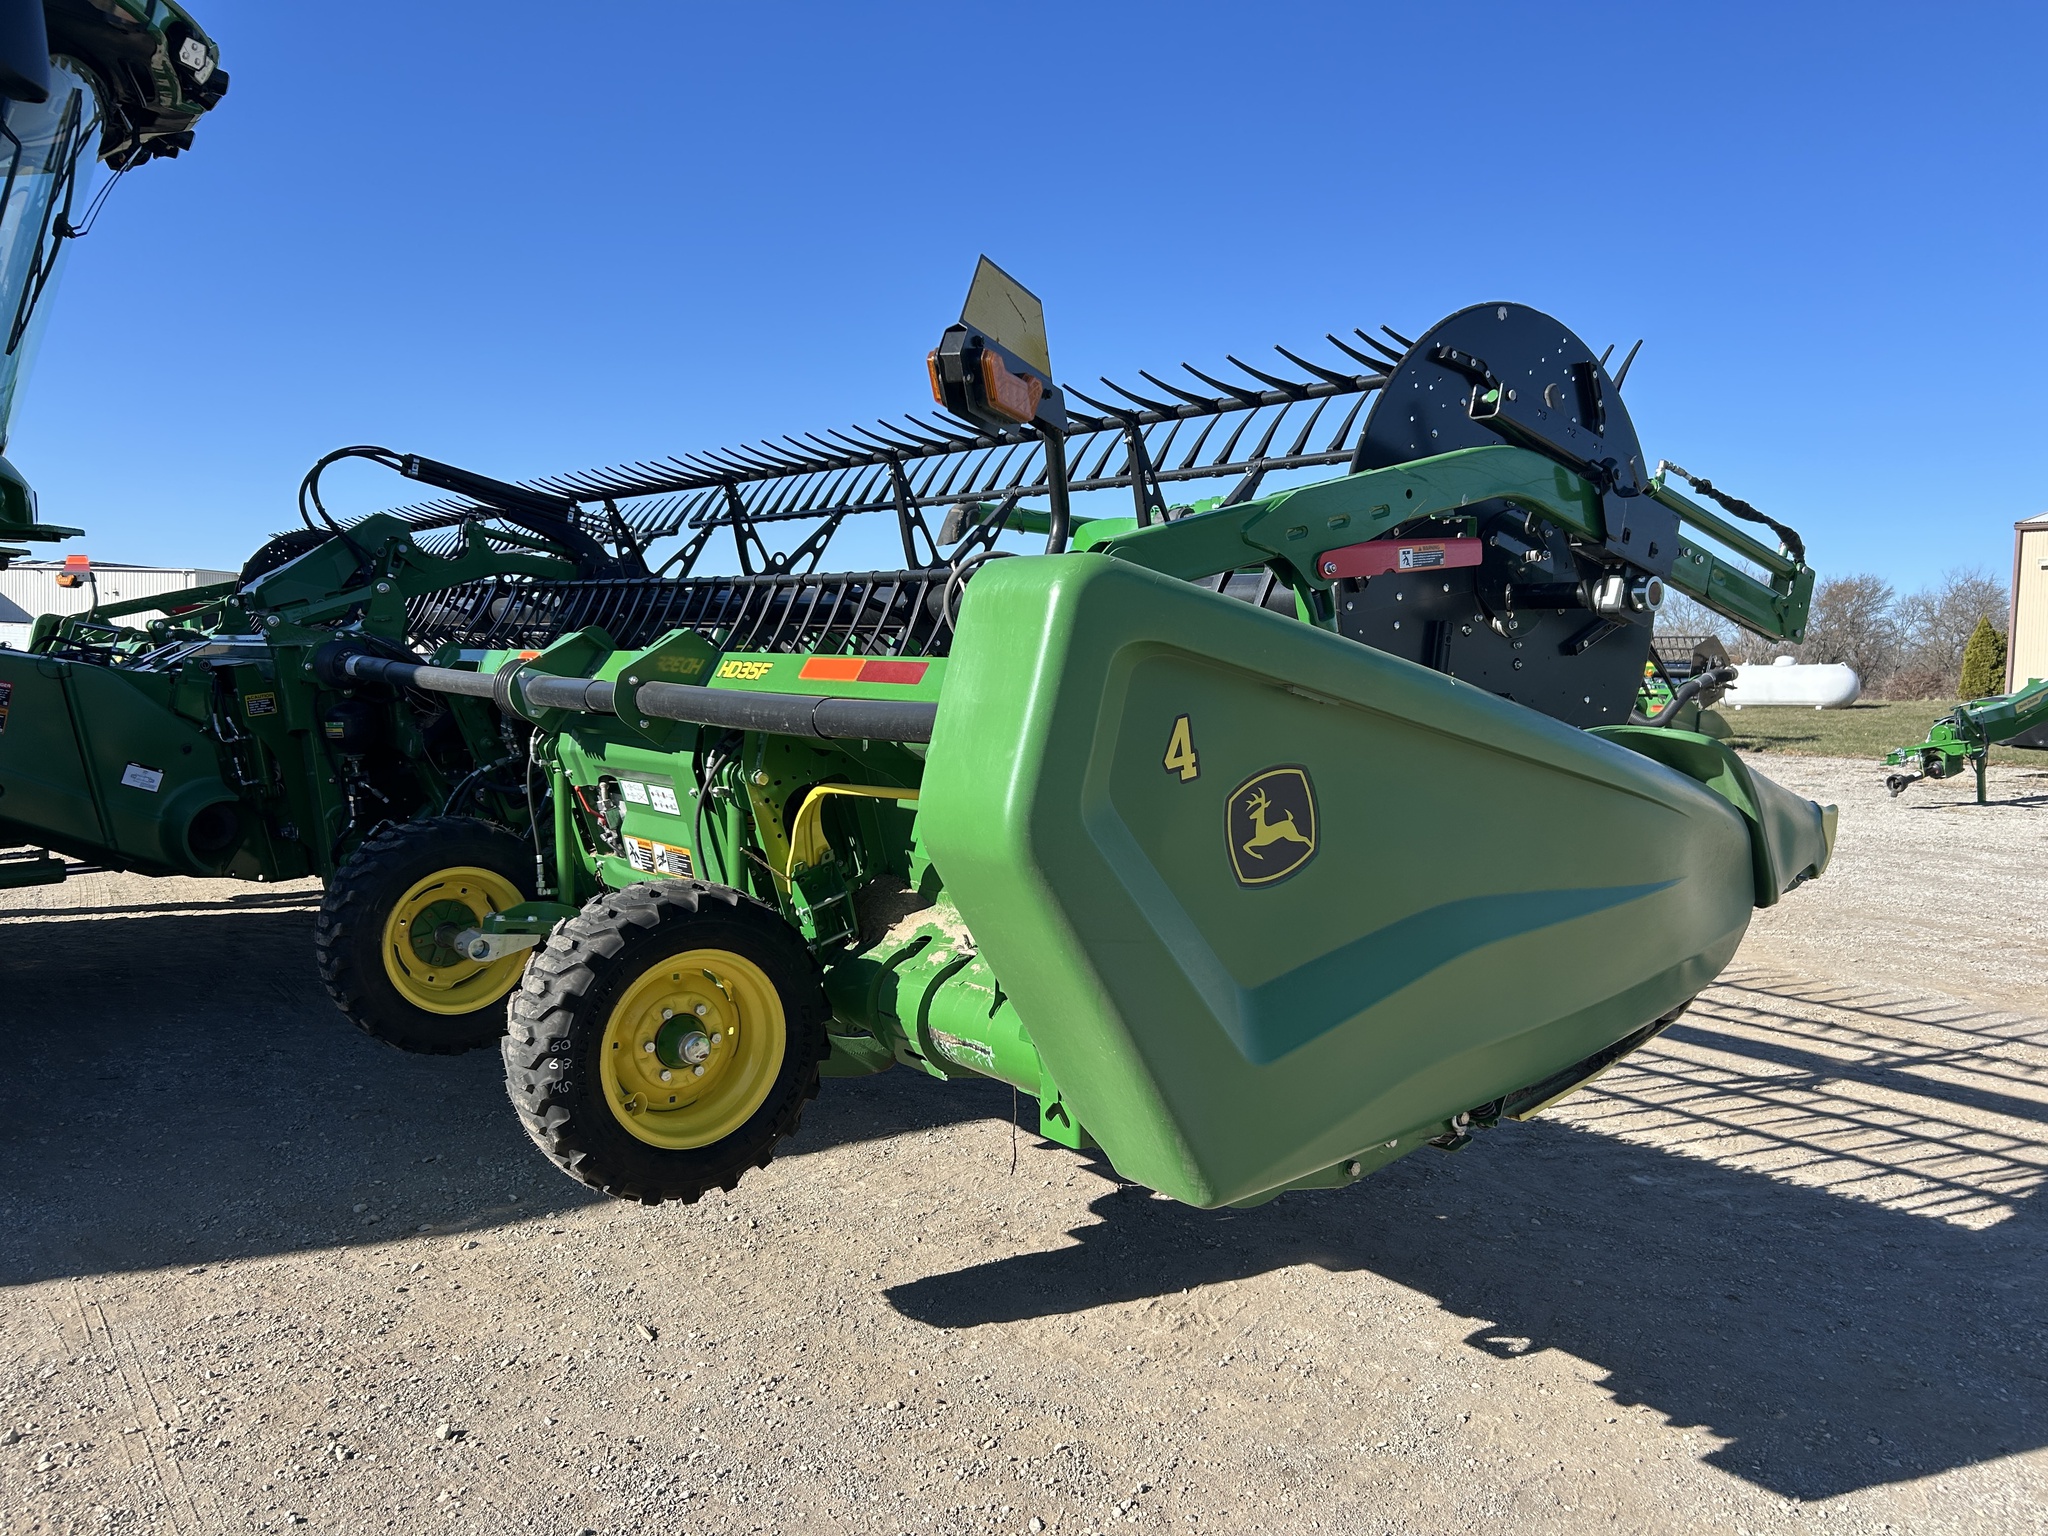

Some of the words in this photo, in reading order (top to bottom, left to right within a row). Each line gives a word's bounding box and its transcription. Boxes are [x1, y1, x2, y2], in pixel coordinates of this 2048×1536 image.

[716, 660, 774, 681] HD35F
[1163, 713, 1201, 784] 4
[550, 1039, 571, 1052] 60
[765, 1003, 813, 1135] CARLISLE
